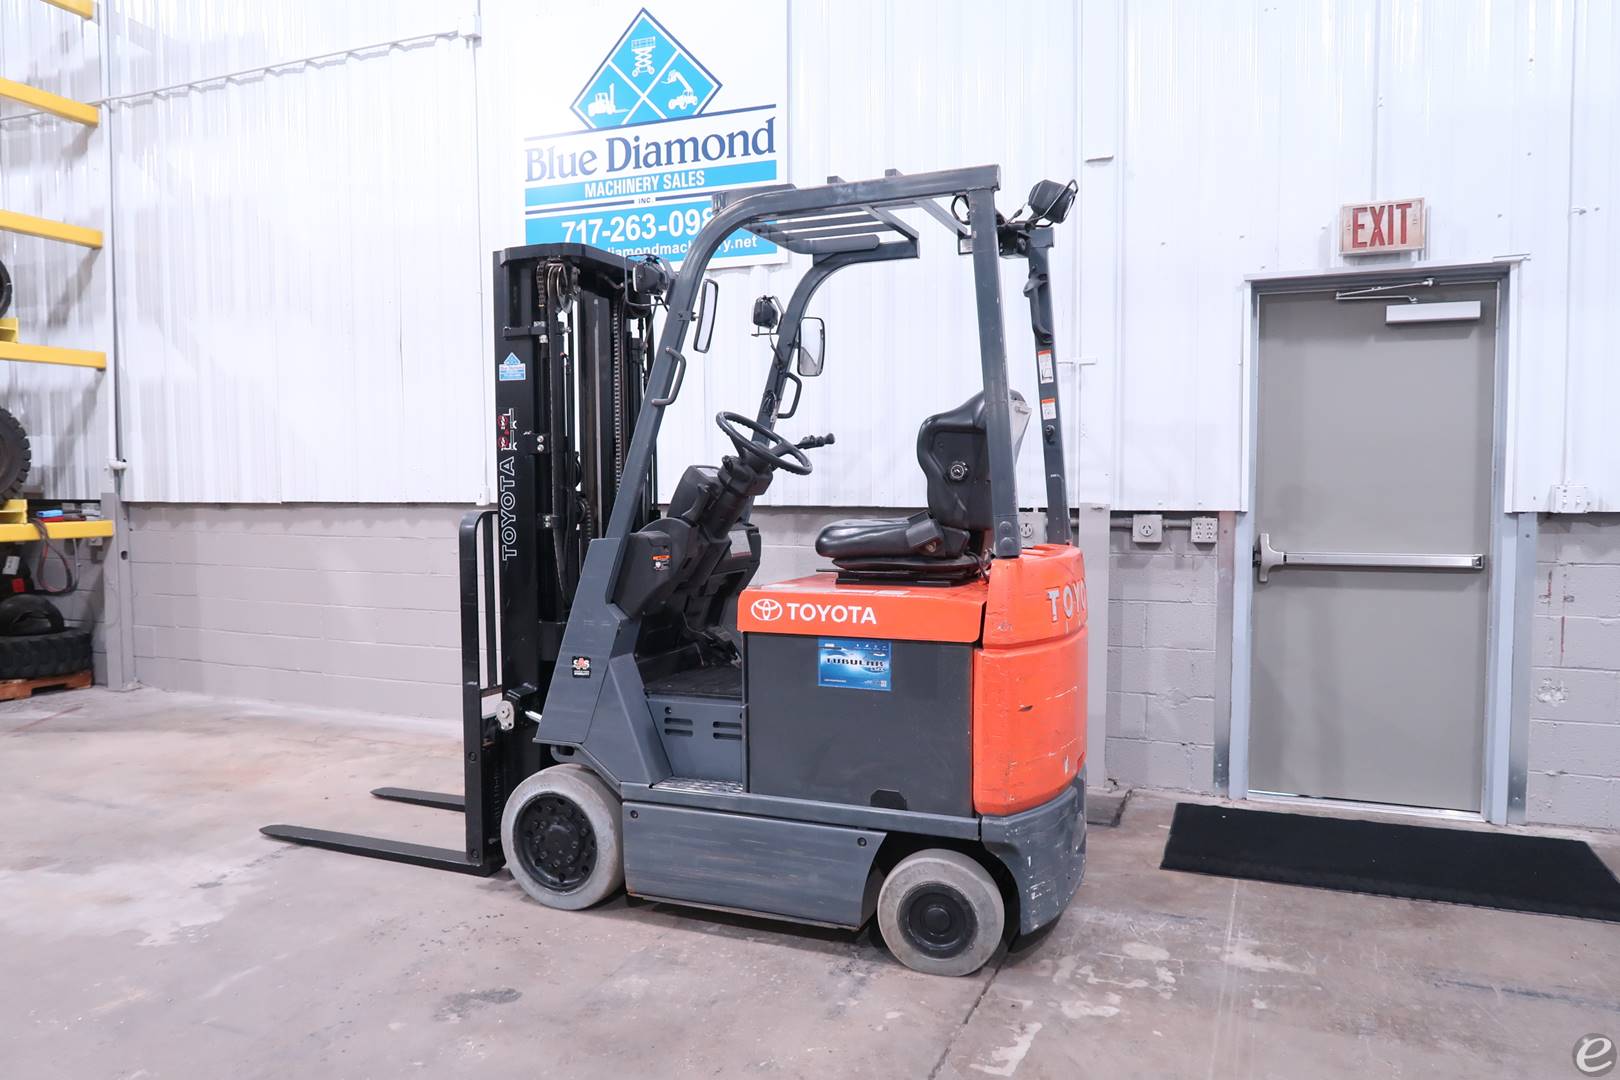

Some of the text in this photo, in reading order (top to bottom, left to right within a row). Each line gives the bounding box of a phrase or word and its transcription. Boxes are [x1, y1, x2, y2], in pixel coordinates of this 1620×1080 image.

[525, 116, 777, 182] Blue Diamond
[584, 170, 705, 199] MACHINERY SALES
[561, 207, 715, 244] 717-263-098
[1352, 203, 1412, 248] EXIT
[500, 456, 517, 561] TOYOTA
[786, 602, 877, 625] TOYOTA
